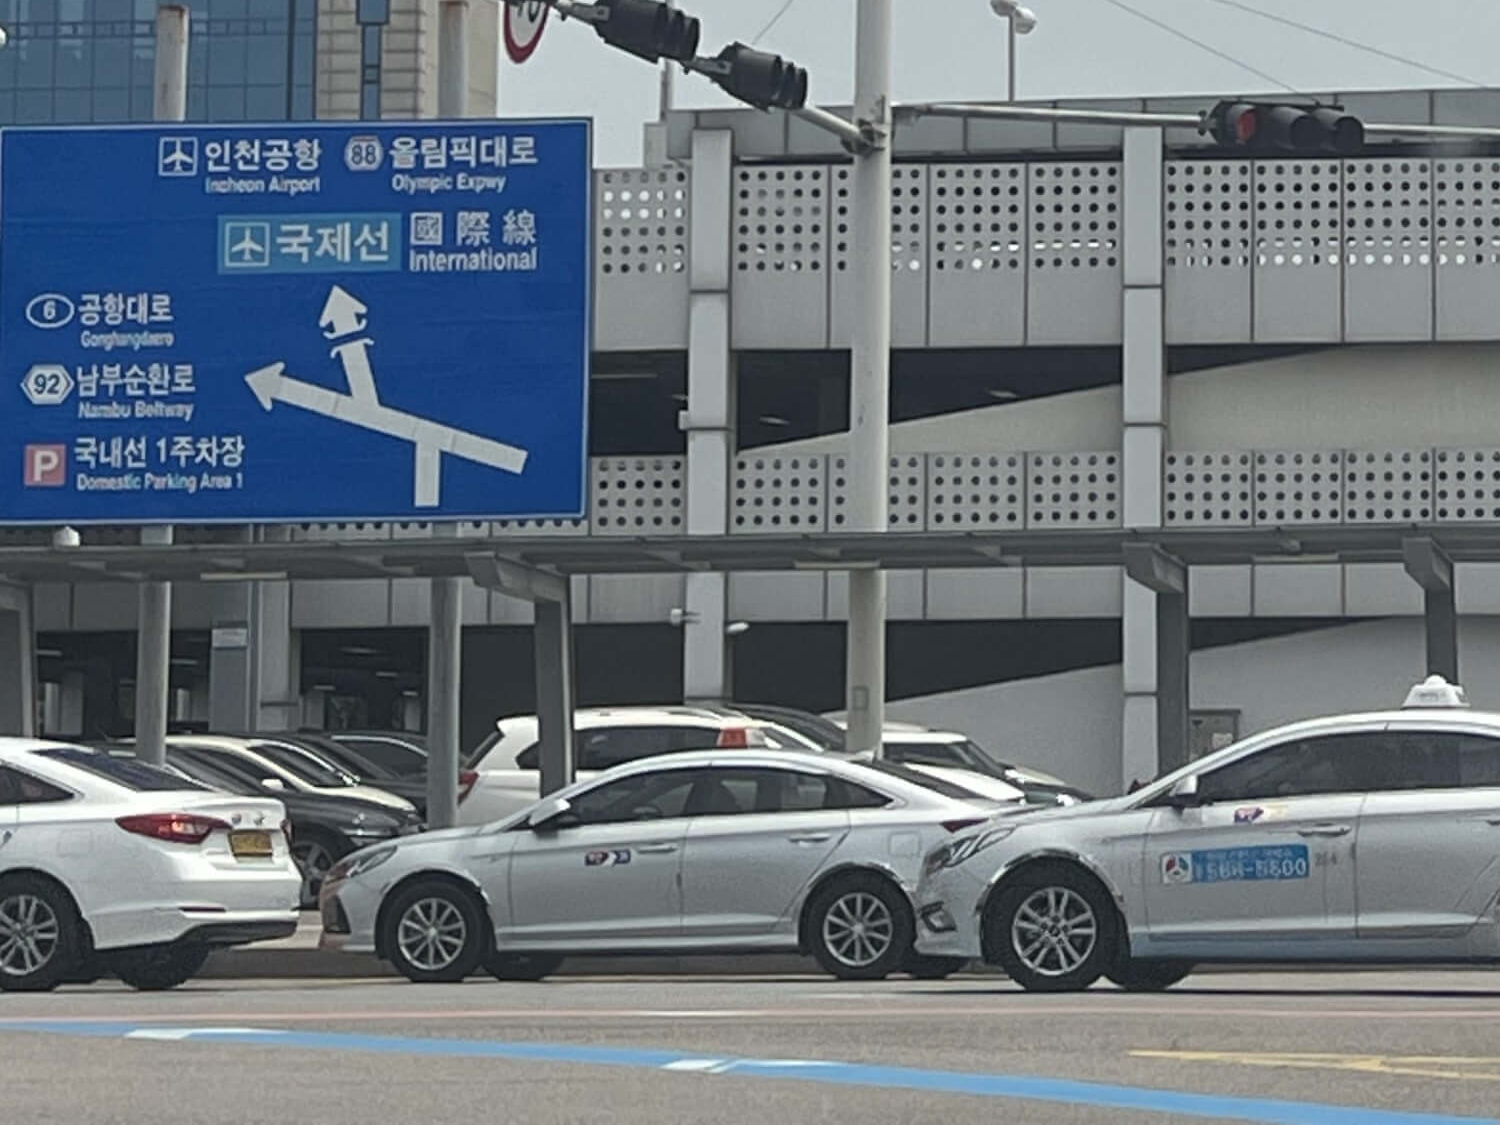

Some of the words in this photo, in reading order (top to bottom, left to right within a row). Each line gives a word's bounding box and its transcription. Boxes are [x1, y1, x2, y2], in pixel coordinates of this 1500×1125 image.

[204, 139, 322, 172] 인천공항
[350, 143, 377, 165] 88
[389, 136, 538, 169] 올림픽대로
[205, 176, 265, 193] Incheon
[269, 175, 320, 195] Airport
[392, 174, 452, 194] Olympic
[457, 174, 507, 194] Expwy
[276, 222, 390, 263] 국제선
[410, 247, 537, 272] International
[43, 301, 56, 320] 6
[79, 293, 173, 326] 공항대로
[34, 374, 60, 395] 92
[77, 364, 196, 397] 남부순환로
[79, 401, 130, 419] Nambu
[135, 401, 194, 421] Beltway
[74, 436, 146, 469] 국내선
[33, 450, 59, 481] P
[77, 474, 141, 491] Domestic
[144, 474, 196, 493] Parking
[200, 473, 233, 489] Area
